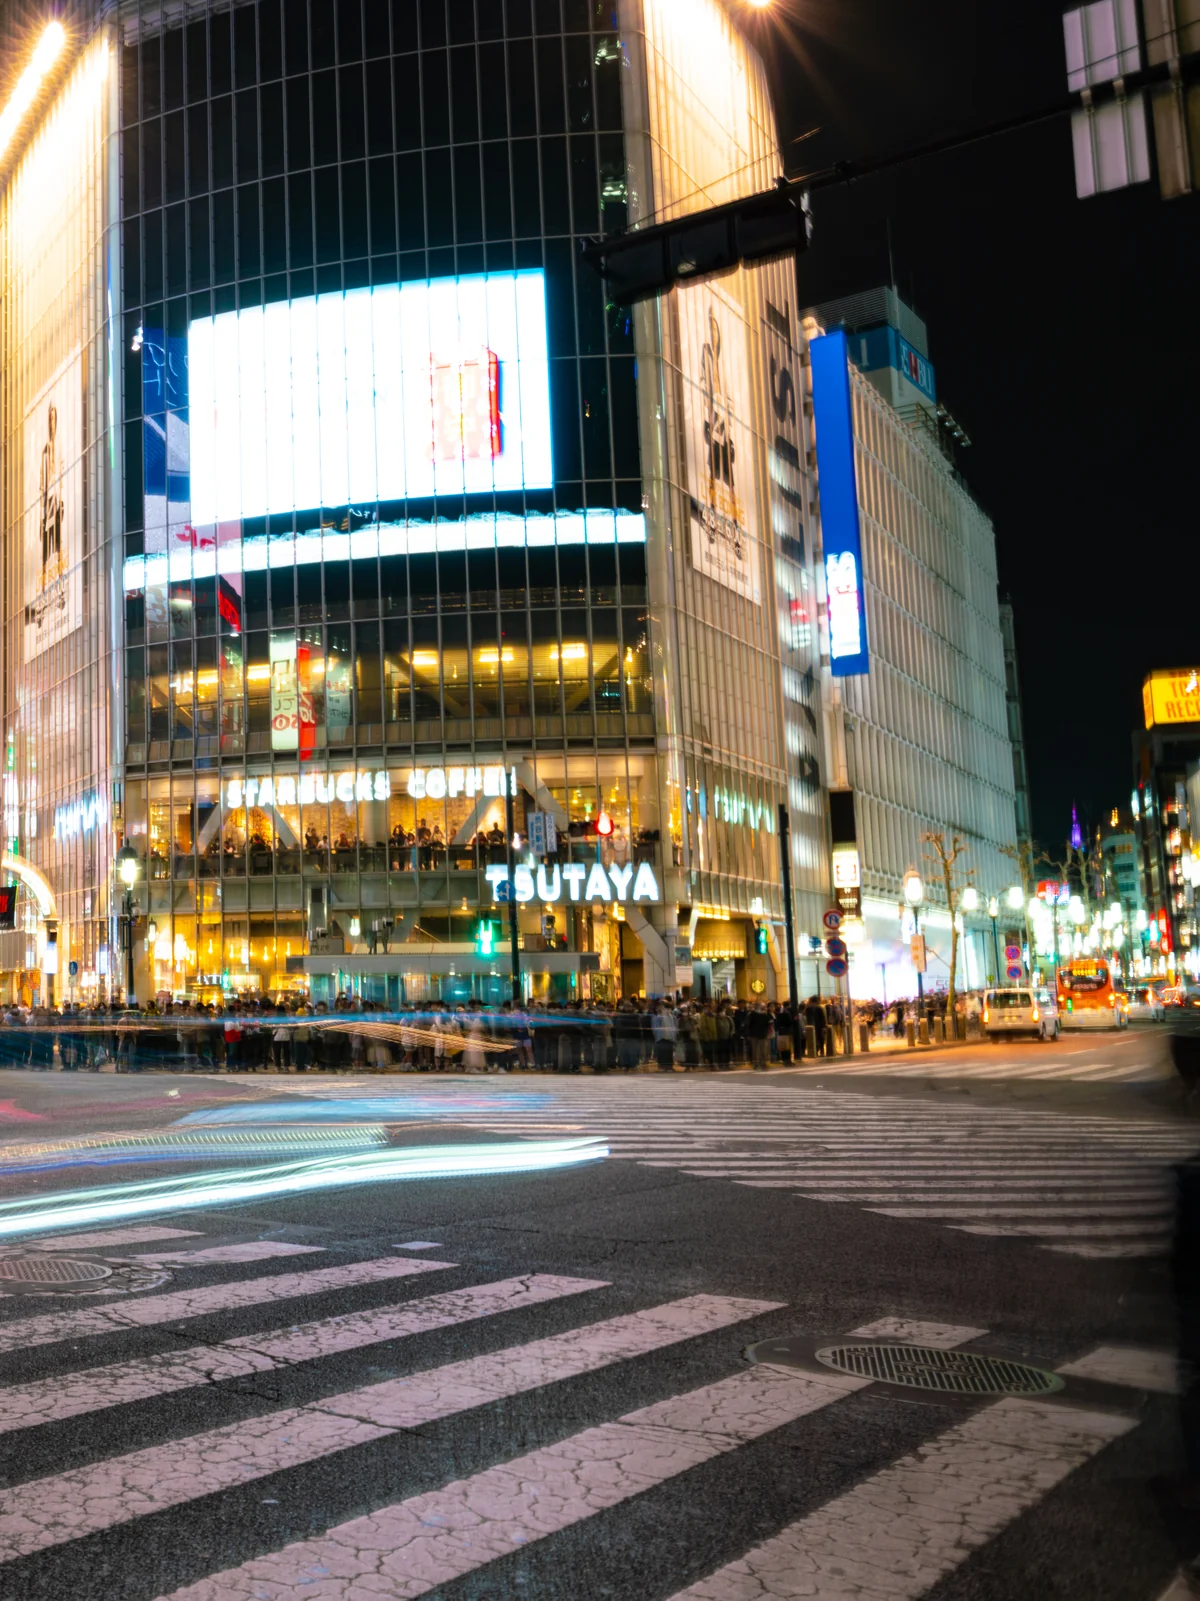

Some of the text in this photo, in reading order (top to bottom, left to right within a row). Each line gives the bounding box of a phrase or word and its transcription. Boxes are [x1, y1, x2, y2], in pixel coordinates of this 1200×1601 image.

[228, 766, 517, 808] STARBUCKS COFFEE
[485, 864, 659, 901] TSUTAYA
